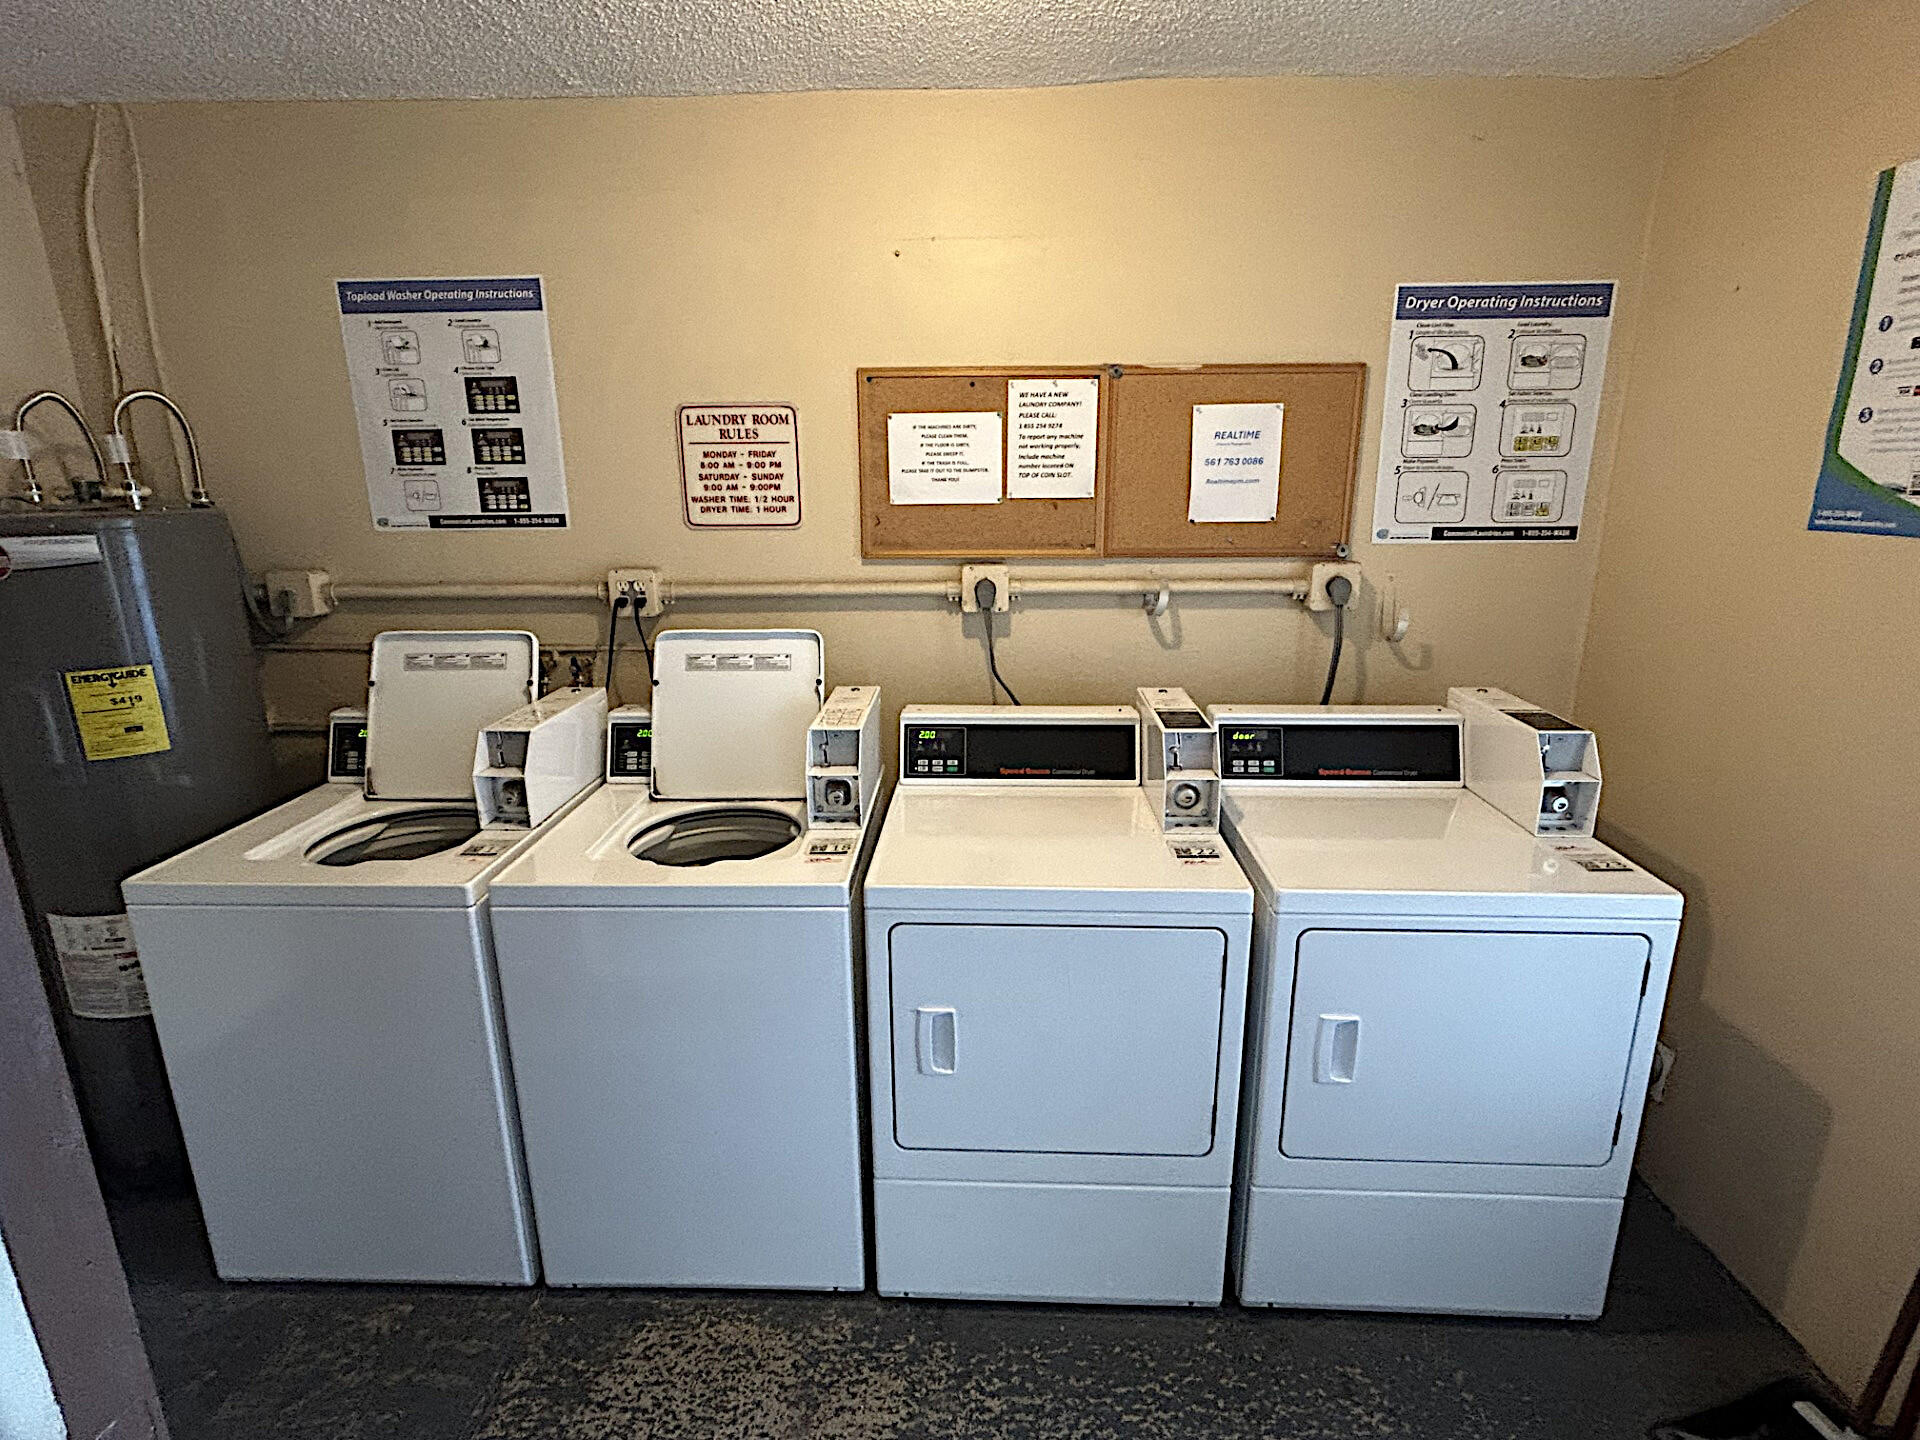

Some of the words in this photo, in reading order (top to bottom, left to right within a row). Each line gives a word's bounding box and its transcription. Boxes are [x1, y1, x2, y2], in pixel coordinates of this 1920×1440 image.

[347, 291, 385, 302] Topload
[387, 290, 422, 300] Washer
[424, 289, 473, 301] Operating
[475, 288, 534, 299] Instructions
[1405, 296, 1444, 312] Dryer
[1447, 295, 1518, 311] Operating
[1520, 293, 1604, 307] Instructions
[1409, 330, 1414, 339] 1
[1507, 329, 1516, 339] 2
[1401, 398, 1408, 408] 3
[1499, 400, 1506, 408] 4
[686, 414, 747, 426] LAUNDRY
[752, 414, 789, 425] ROOM
[719, 428, 758, 439] RULES
[1214, 430, 1261, 439] REALTIME
[702, 451, 737, 459] MONDAY
[748, 450, 777, 458] FRIDAY
[1204, 457, 1221, 466] 561
[1223, 457, 1240, 466] 763
[1241, 456, 1264, 465] 0086
[1394, 465, 1402, 475] 5
[1492, 464, 1499, 474] 6
[698, 473, 740, 481] SATURDAY
[751, 472, 784, 480] SUNDAY
[691, 495, 726, 503] WASHER
[700, 505, 727, 513] DRYER
[763, 505, 787, 513] HOUR
[918, 730, 936, 739] 200
